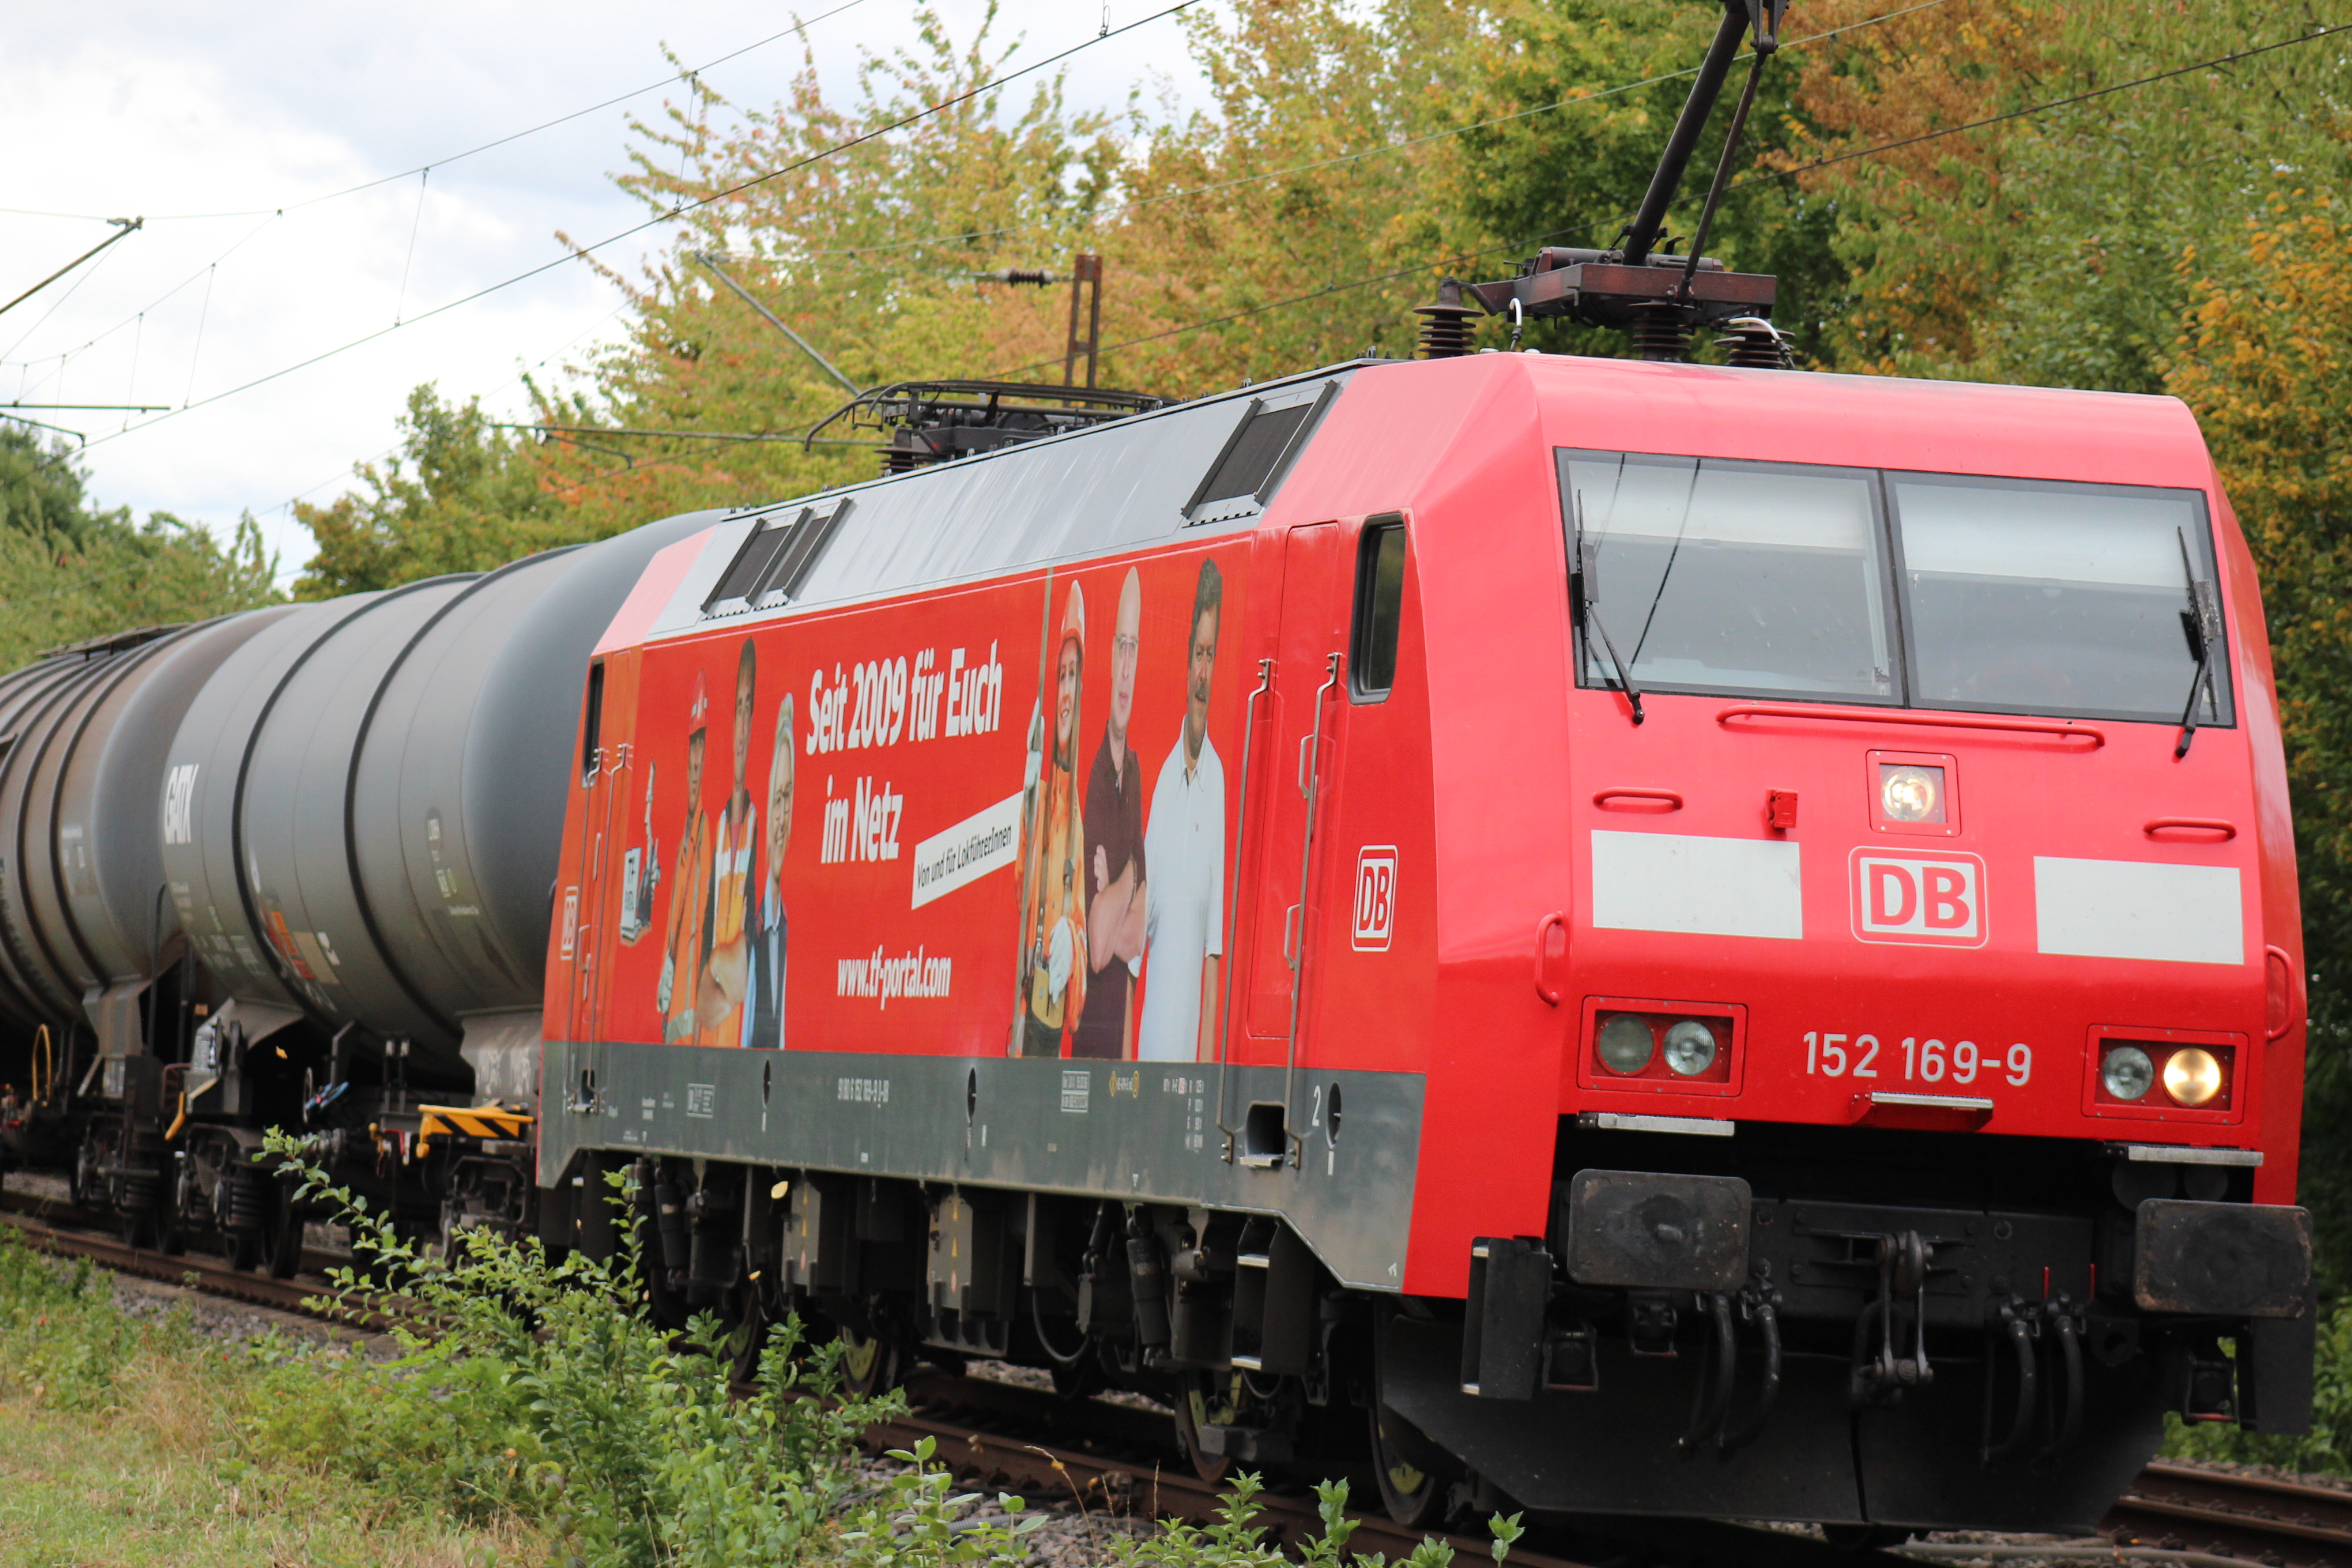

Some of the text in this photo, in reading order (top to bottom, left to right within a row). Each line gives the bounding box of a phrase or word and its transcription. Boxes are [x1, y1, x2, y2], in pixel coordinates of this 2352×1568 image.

[806, 638, 1003, 755] Seit 2009 für Euch
[821, 774, 904, 864] im Netz
[917, 824, 1012, 889] Von und für LokführerInnen
[1358, 865, 1390, 931] DB
[1868, 863, 1970, 930] DB
[836, 943, 952, 1011] www.tf-portal.com
[1803, 1030, 2033, 1087] 152 169-9
[1311, 1084, 1322, 1127] 2
